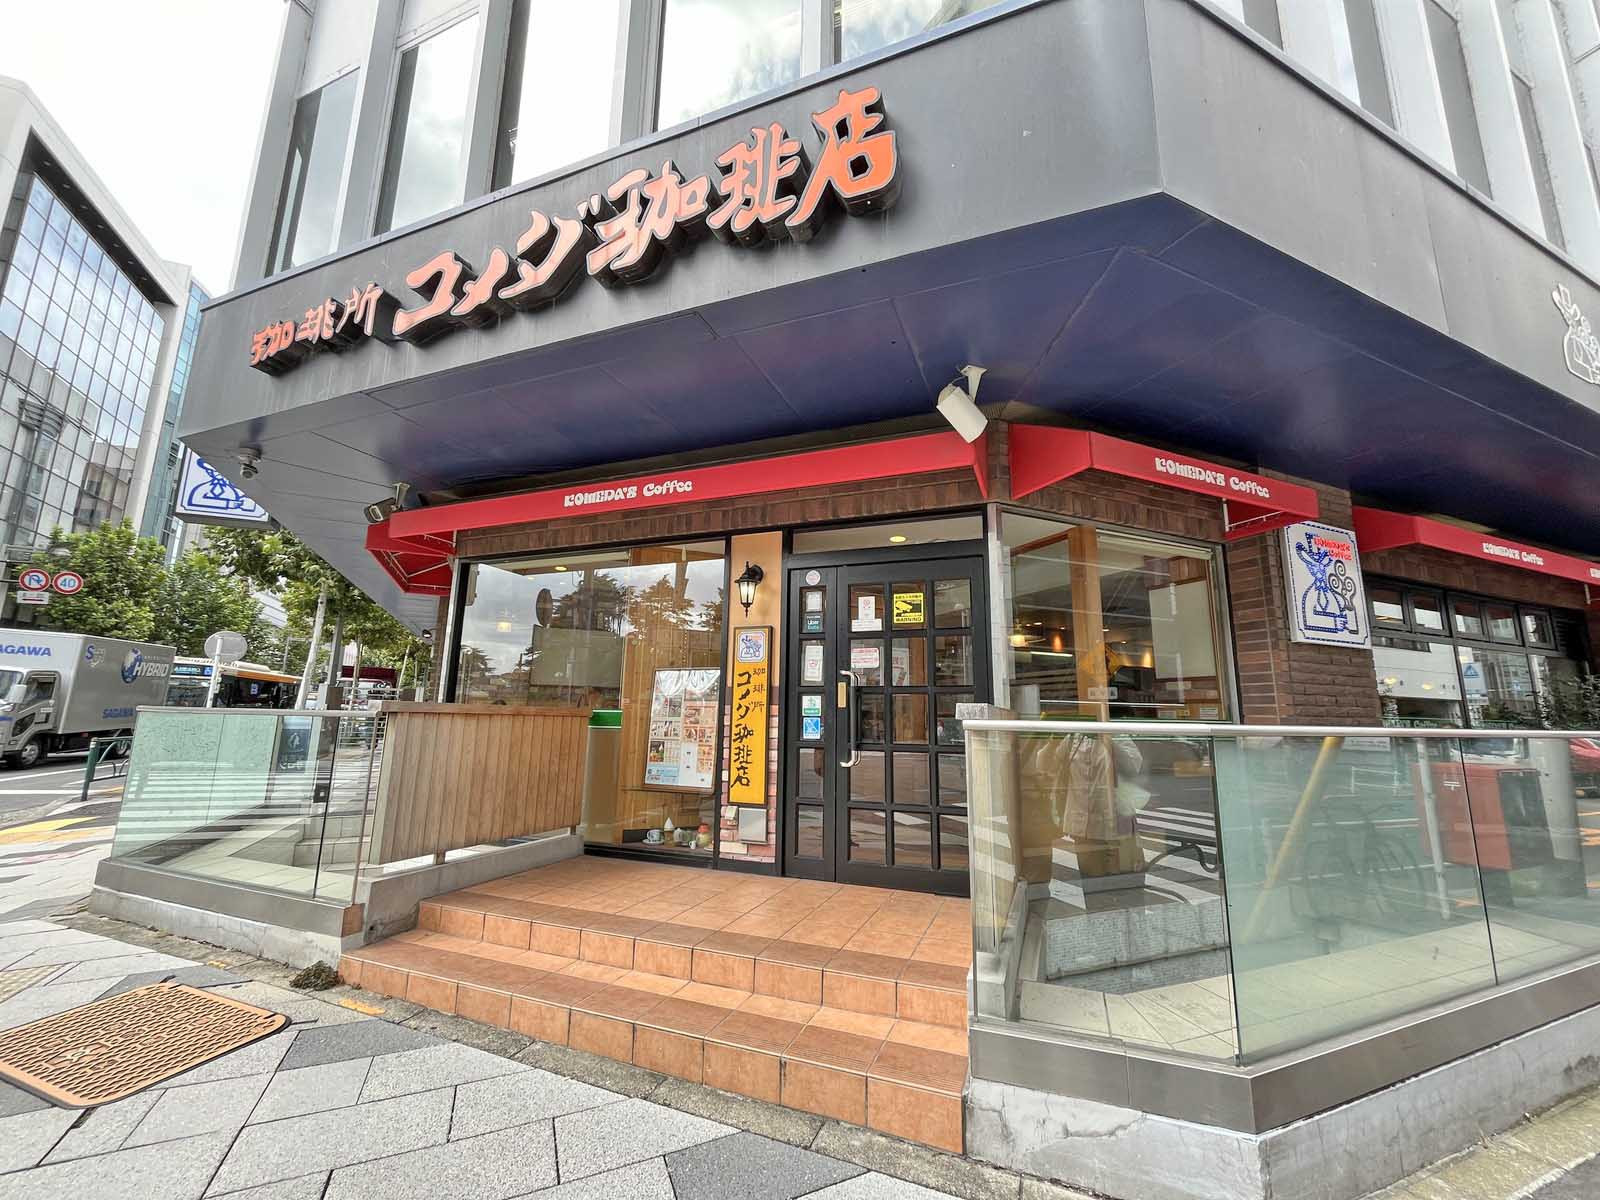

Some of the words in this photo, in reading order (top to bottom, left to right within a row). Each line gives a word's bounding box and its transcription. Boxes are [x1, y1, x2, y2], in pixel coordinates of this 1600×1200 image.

[392, 86, 897, 337] コメダ珈琲店
[1154, 457, 1226, 487] KOMEDA'S
[1229, 476, 1271, 498] Coffee
[564, 486, 638, 507] KOMEDA'S
[642, 480, 693, 497] Coffee
[1521, 551, 1544, 566] Coffee
[60, 578, 77, 588] 40
[133, 662, 169, 677] HYBRID
[730, 671, 754, 788] コメダ珈琲店
